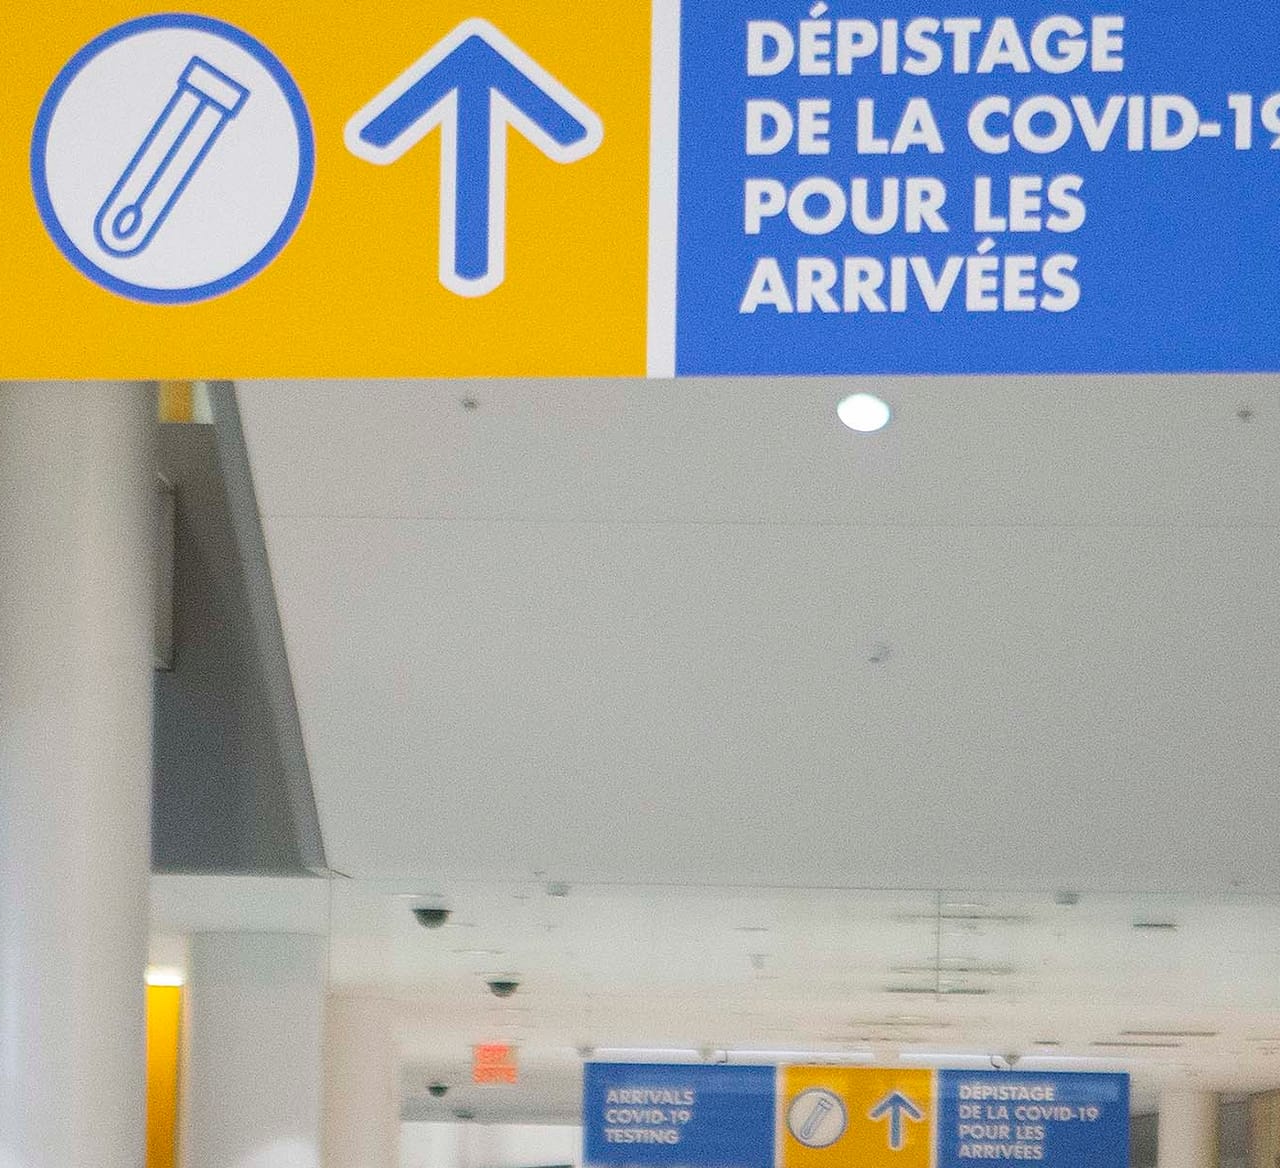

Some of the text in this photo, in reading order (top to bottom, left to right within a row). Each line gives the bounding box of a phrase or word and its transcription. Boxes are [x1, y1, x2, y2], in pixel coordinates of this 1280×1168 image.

[747, 3, 1125, 77] DÉPISTAGE
[746, 99, 830, 156] DE
[855, 98, 945, 155] LA
[744, 175, 1087, 236] POUR LES
[739, 239, 1081, 315] ARRIVÉES
[605, 1089, 695, 1106] ARRIVALS
[604, 1107, 692, 1125] COVID-19
[958, 1104, 1100, 1122] DE LA COVID-19
[604, 1127, 680, 1145] TESTING
[958, 1124, 1045, 1141] POUR LES
[958, 1142, 1044, 1160] ARRIVÉES
